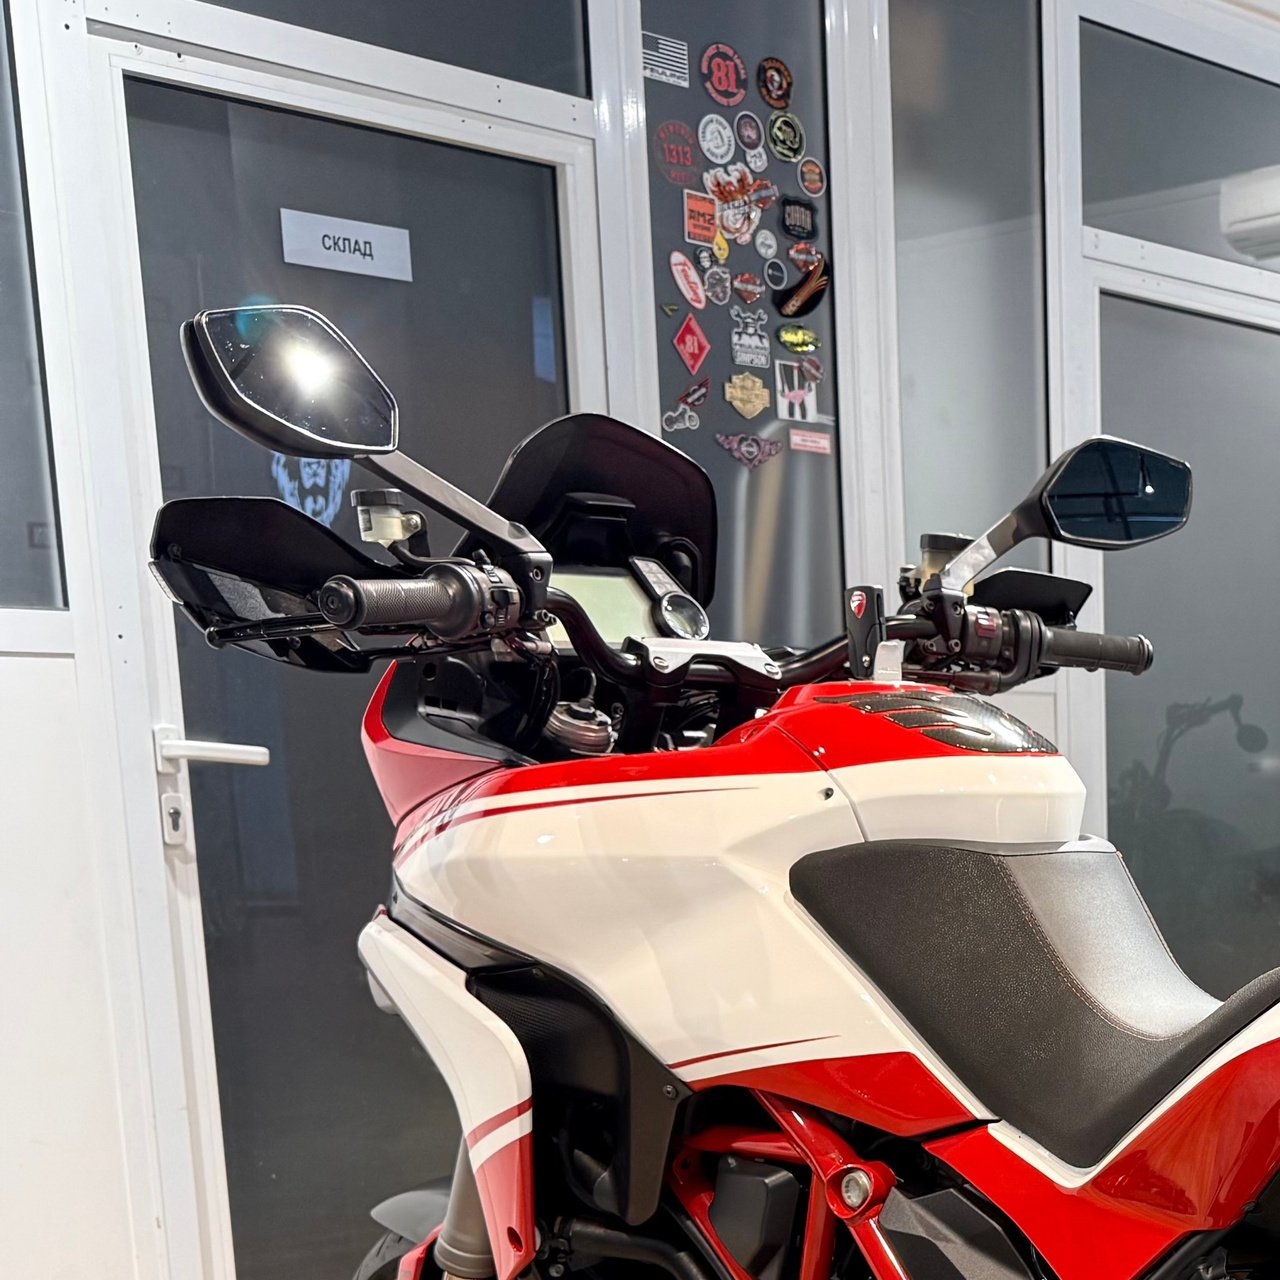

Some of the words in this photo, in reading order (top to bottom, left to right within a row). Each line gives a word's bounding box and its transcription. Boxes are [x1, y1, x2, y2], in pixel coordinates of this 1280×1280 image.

[710, 57, 740, 93] 81
[663, 143, 693, 166] 1313
[321, 233, 375, 261] СКЛАД
